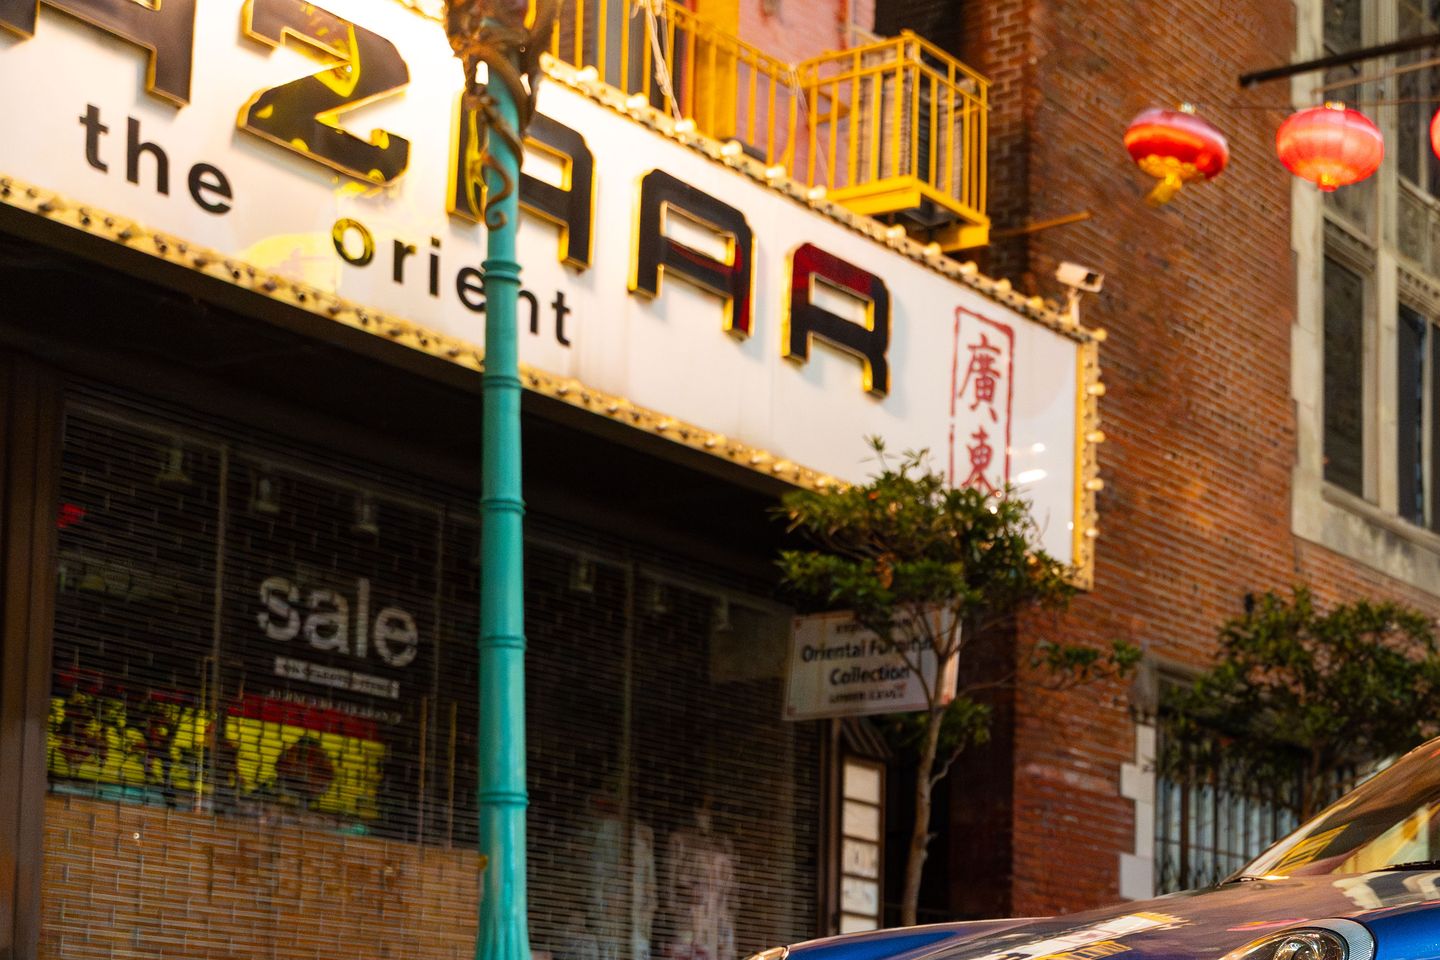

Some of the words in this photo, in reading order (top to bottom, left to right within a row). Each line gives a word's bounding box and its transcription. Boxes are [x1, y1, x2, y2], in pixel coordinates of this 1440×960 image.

[79, 103, 233, 214] the
[332, 217, 571, 347] orient
[958, 333, 1002, 496] 廣東
[256, 576, 419, 667] sale
[802, 639, 865, 662] Oriental
[830, 665, 909, 686] Collection
